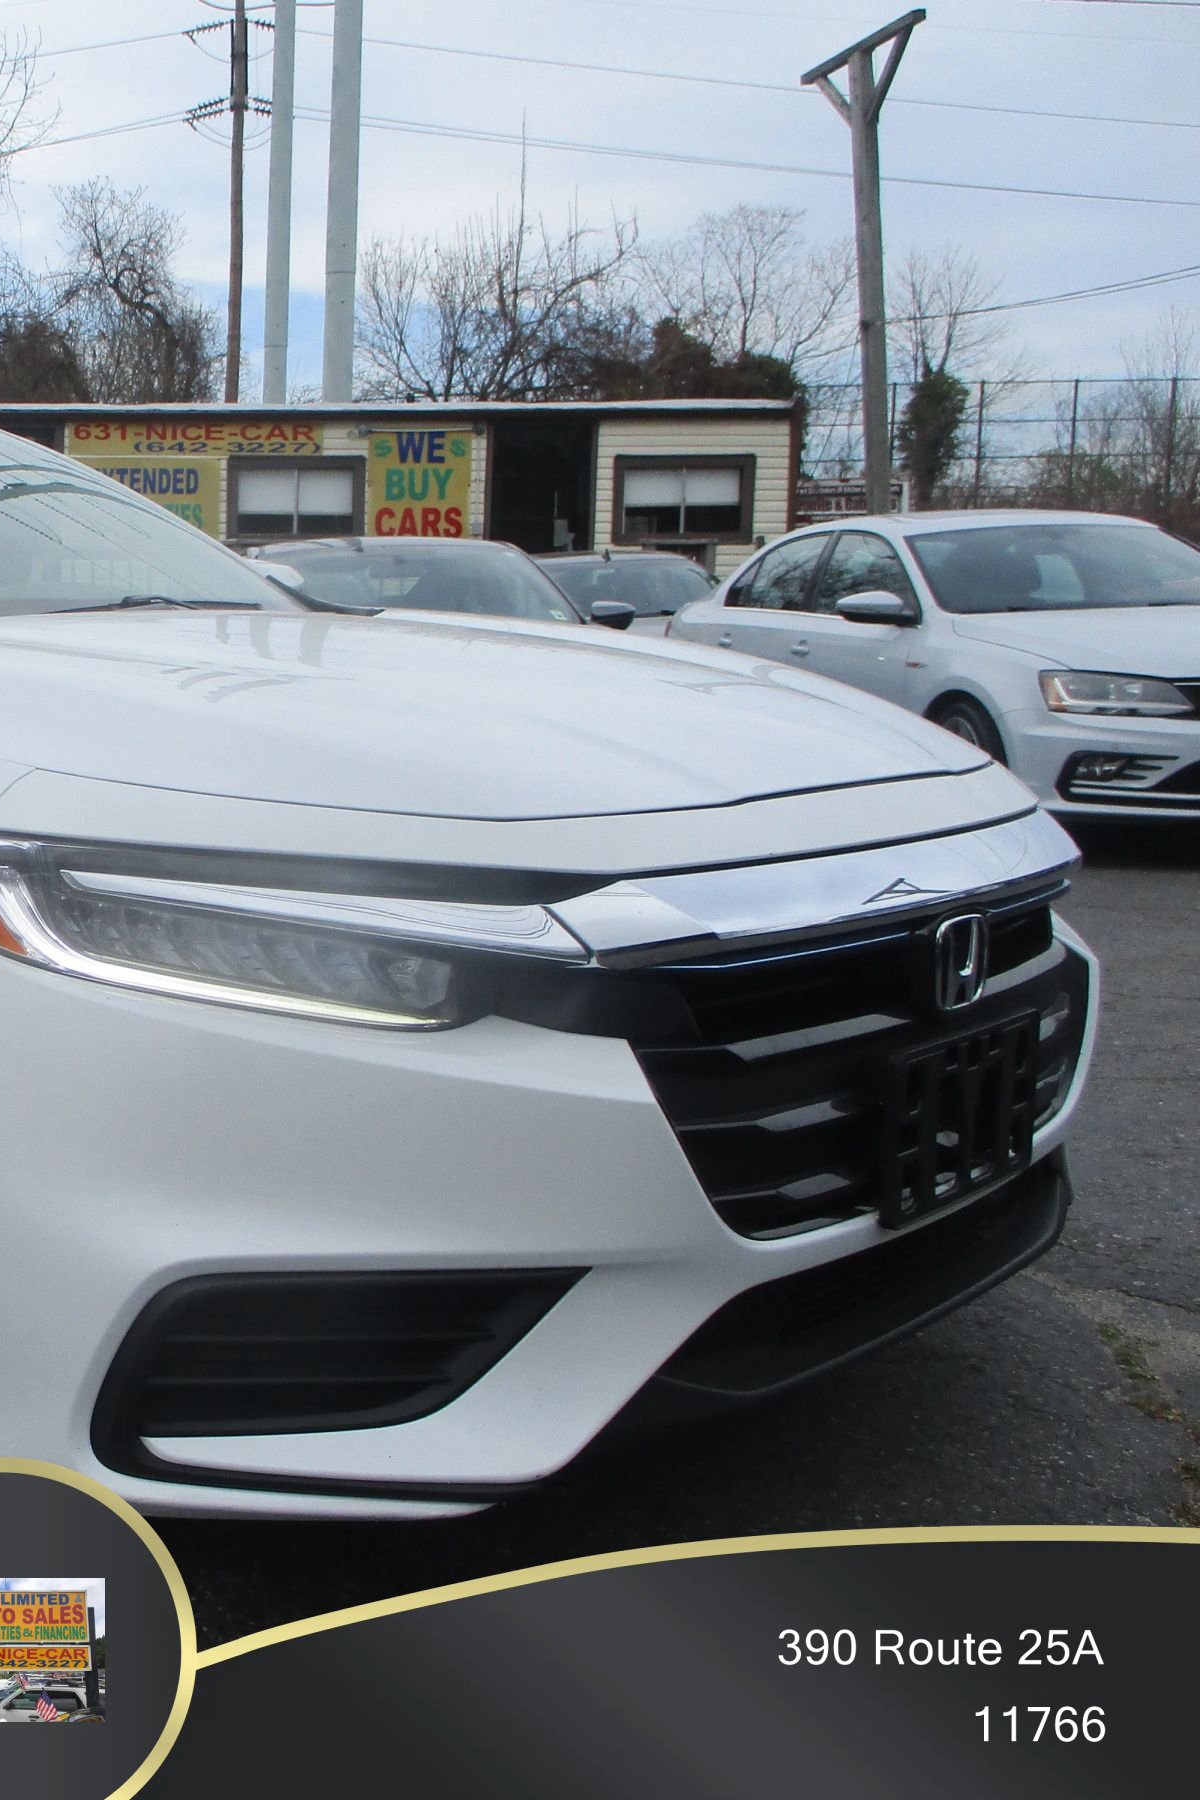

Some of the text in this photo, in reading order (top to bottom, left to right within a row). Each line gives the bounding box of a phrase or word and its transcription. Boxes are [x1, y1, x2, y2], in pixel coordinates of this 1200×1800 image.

[73, 423, 315, 441] 631-NICE-CAR
[133, 441, 321, 454] (642-3227)
[396, 430, 446, 464] WE
[385, 467, 453, 501] BUY
[375, 506, 462, 537] CARS
